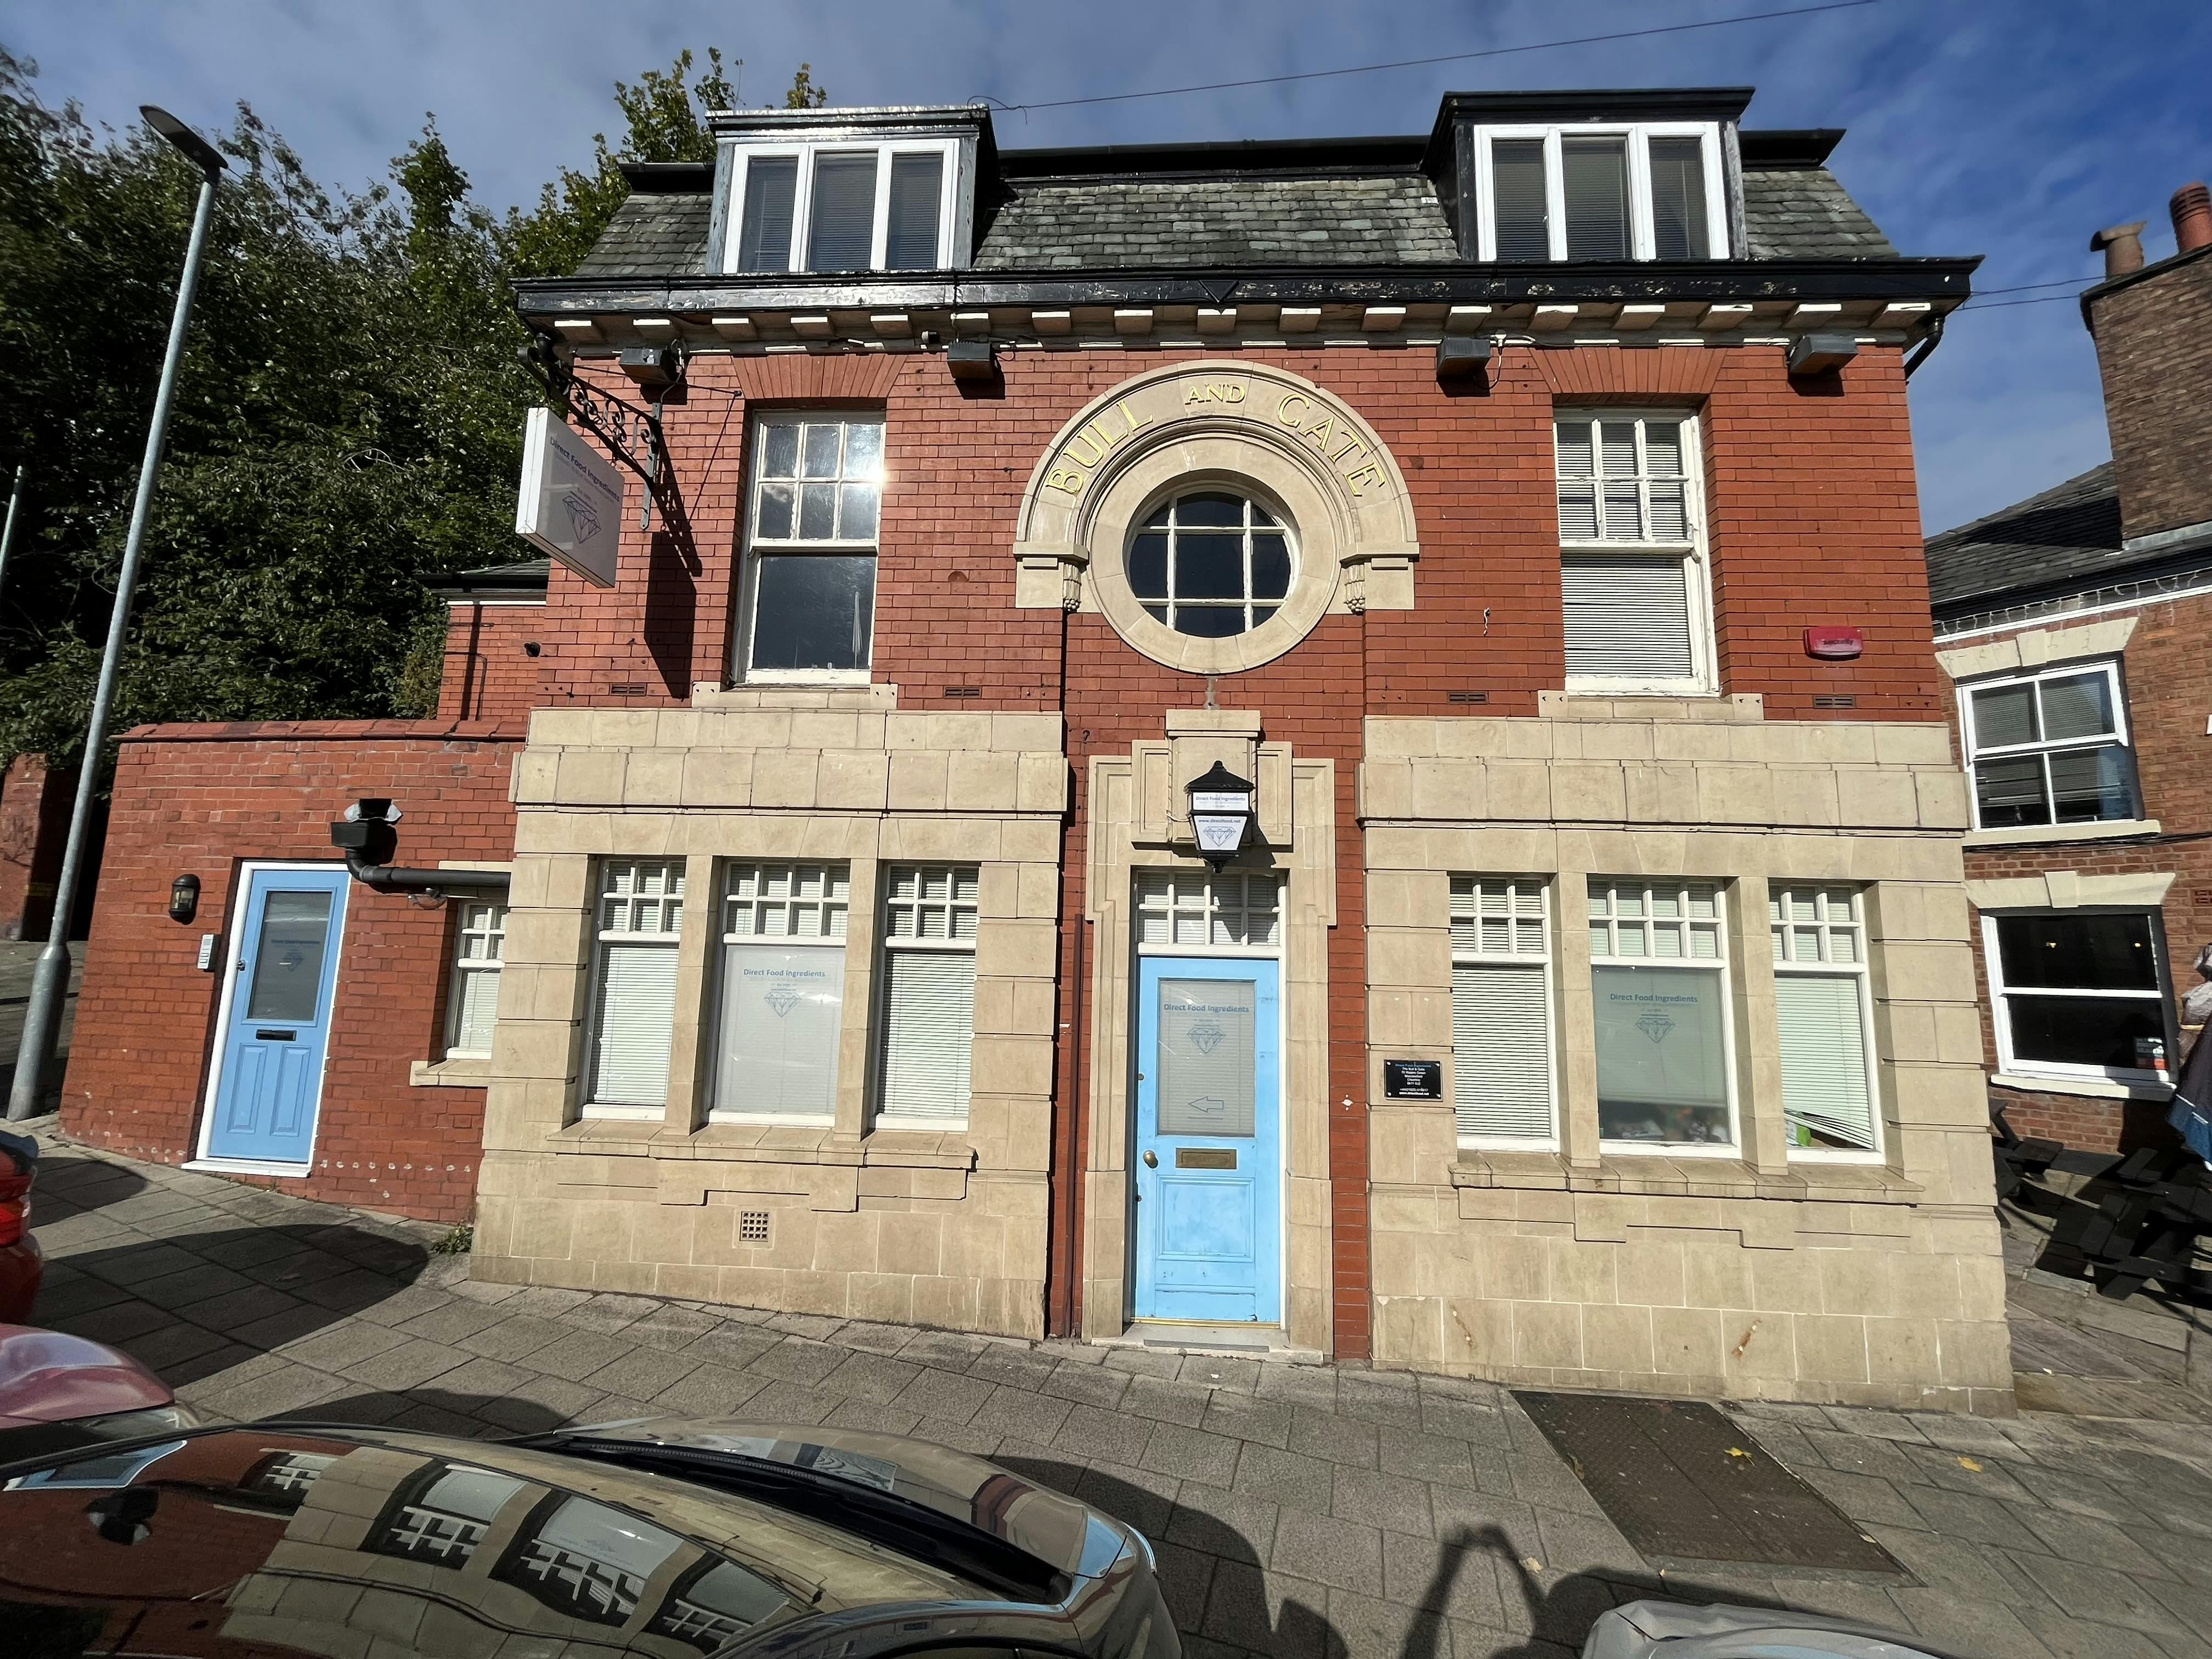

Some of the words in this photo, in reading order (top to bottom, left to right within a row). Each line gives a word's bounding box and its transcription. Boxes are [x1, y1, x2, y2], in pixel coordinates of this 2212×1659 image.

[1046, 400, 1153, 495] BULL
[1185, 383, 1246, 405] AND
[1277, 393, 1387, 497] GATE
[550, 436, 570, 460] Direct
[571, 454, 587, 473] Food
[588, 469, 620, 502] Ingredients
[1207, 1005, 1249, 1013] Ingredients
[1655, 995, 1699, 1003] Ingredients
